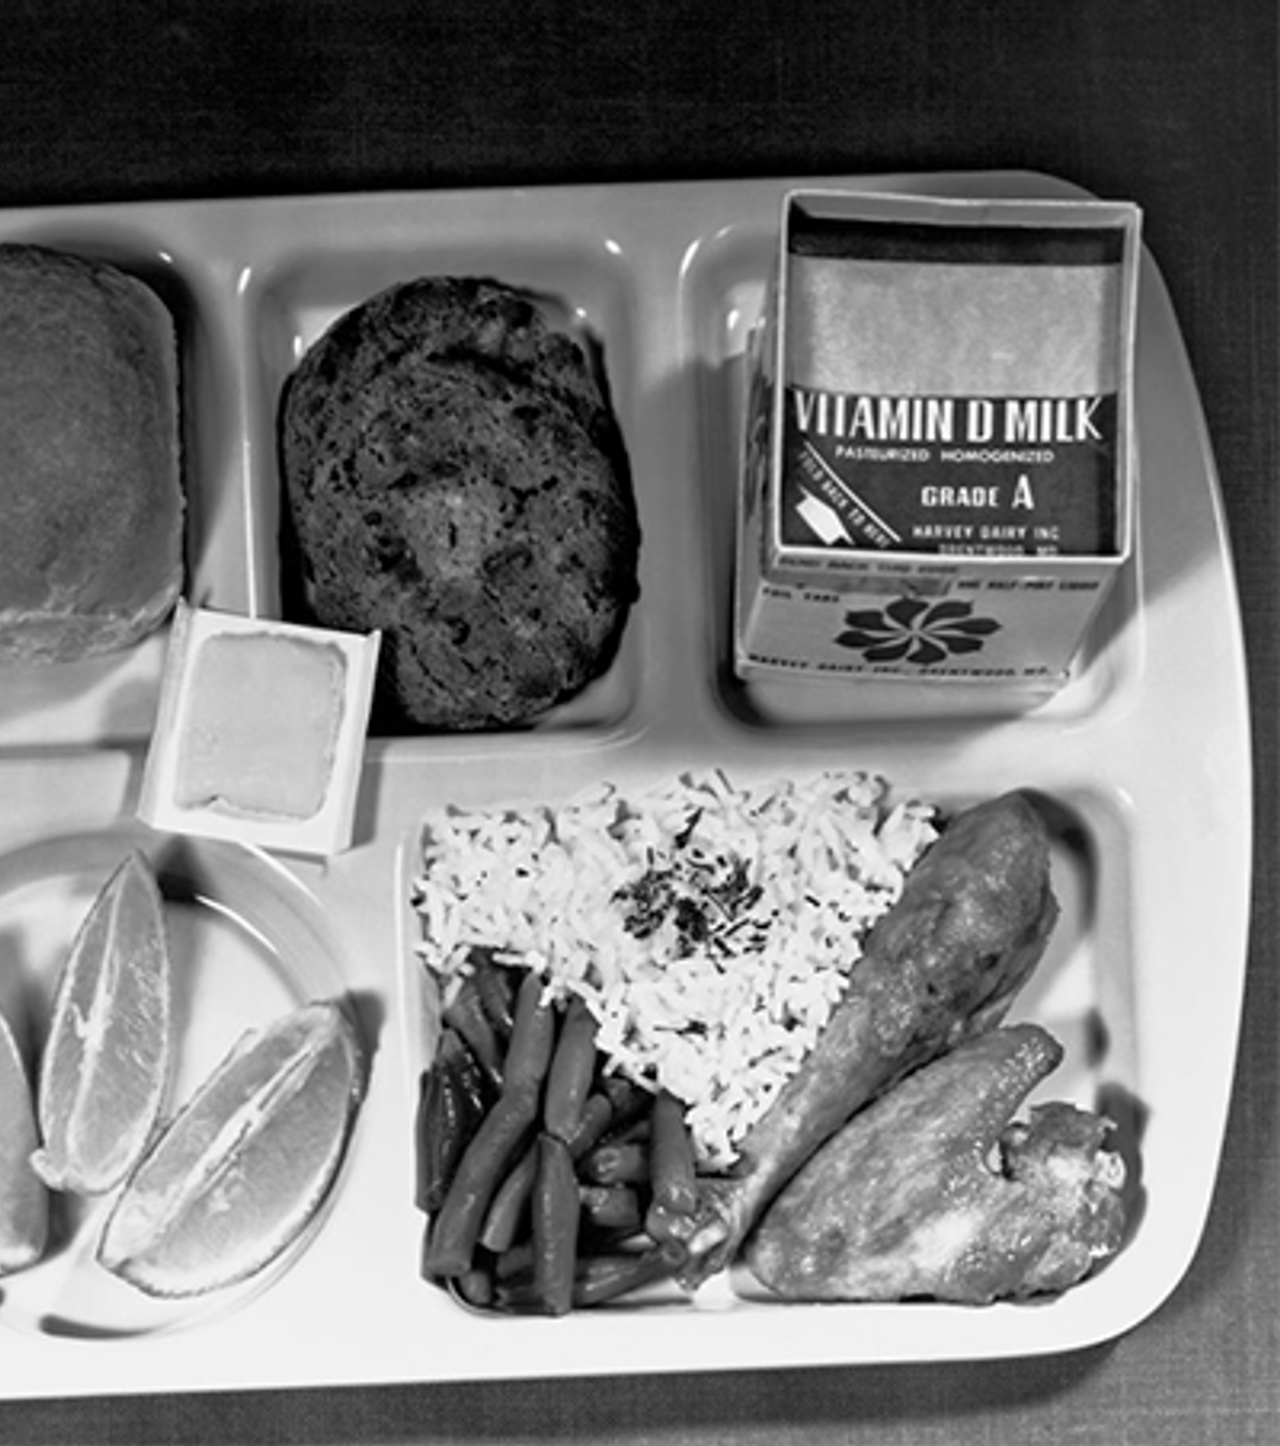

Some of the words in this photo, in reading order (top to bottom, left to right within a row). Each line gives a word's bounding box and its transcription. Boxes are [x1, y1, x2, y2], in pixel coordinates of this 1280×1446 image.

[794, 390, 952, 442] VITAMIN
[968, 399, 994, 443] D
[1006, 398, 1104, 443] MILK
[834, 445, 931, 463] PASTEURIZED
[940, 448, 1056, 464] HOMOGENIZED
[920, 485, 1000, 508] GRADE
[1010, 473, 1035, 510] A
[848, 508, 865, 526] TO
[912, 525, 973, 540] HARVEY
[979, 525, 1028, 540] DAIRY
[1033, 524, 1060, 541] INC
